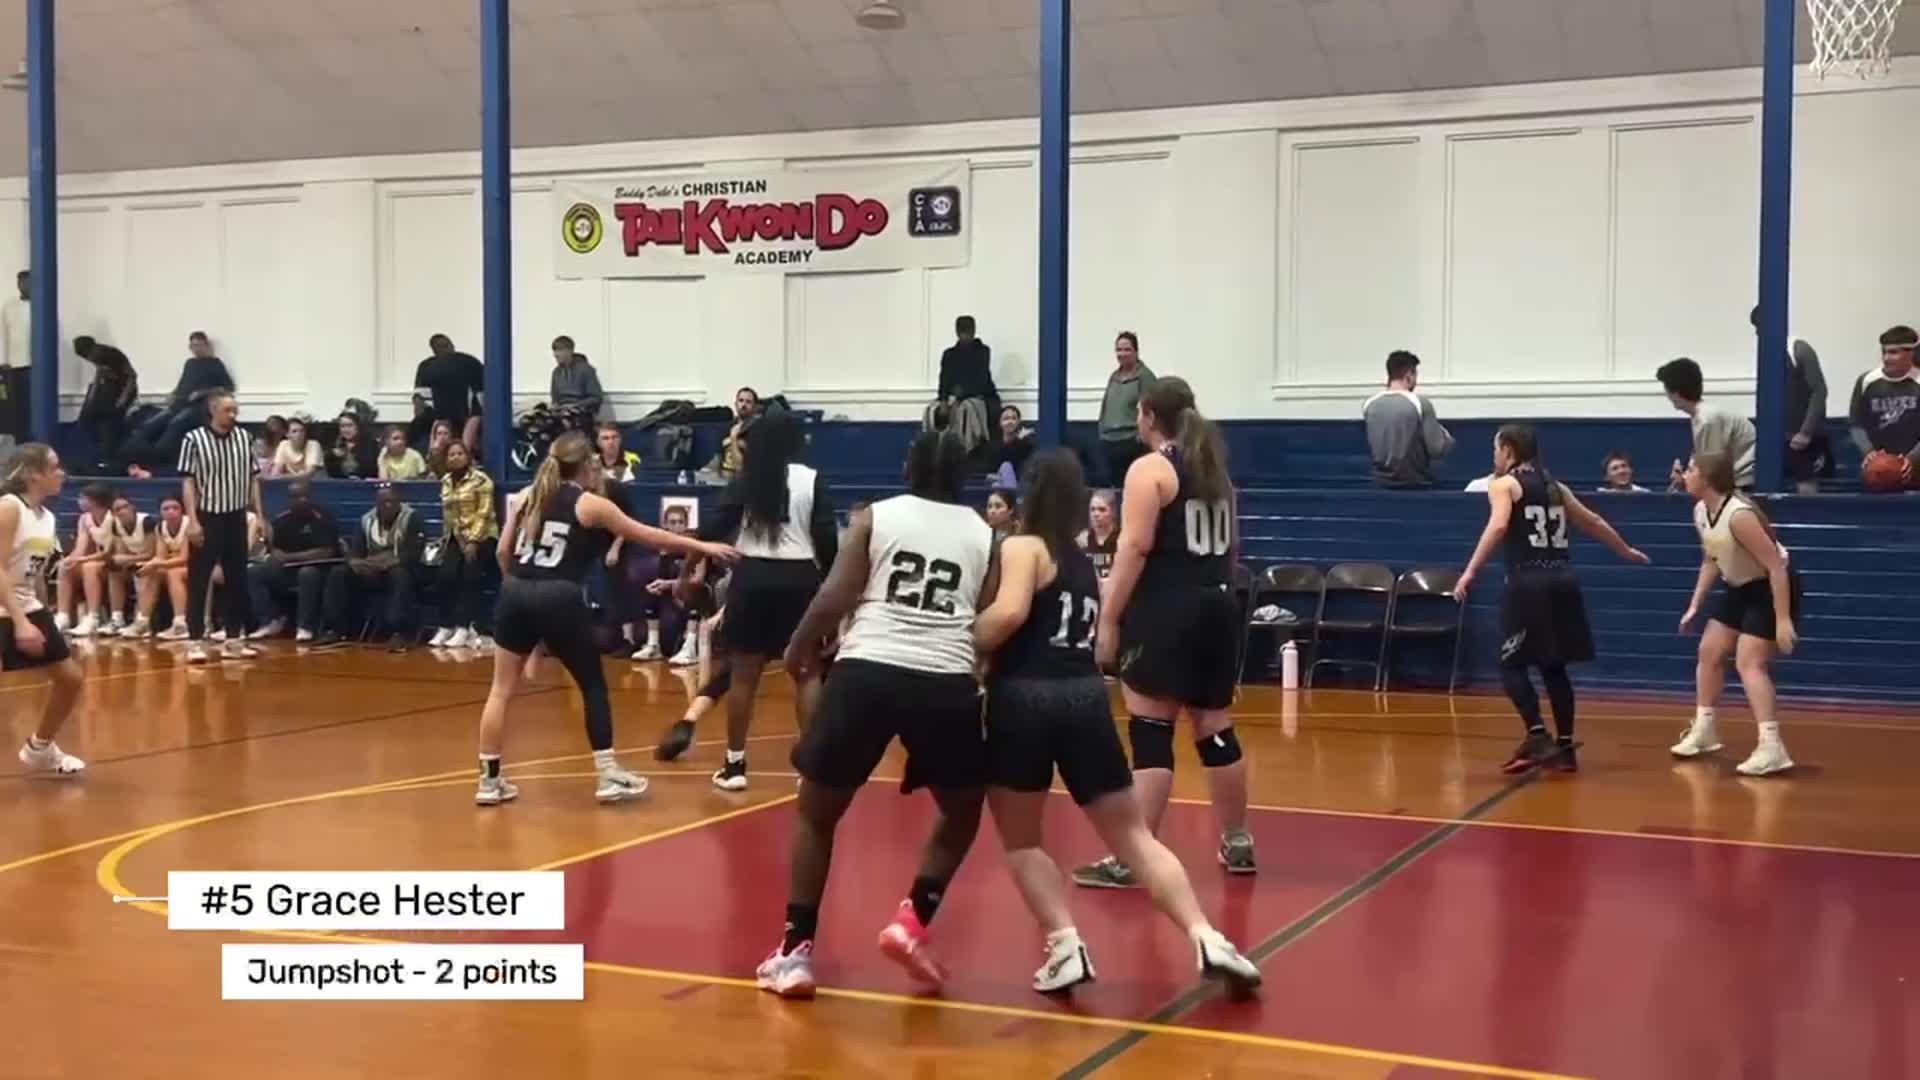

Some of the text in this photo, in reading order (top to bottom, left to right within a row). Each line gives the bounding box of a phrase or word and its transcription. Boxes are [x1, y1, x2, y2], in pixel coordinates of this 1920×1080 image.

[682, 180, 767, 196] CHRISTIAN
[734, 249, 813, 265] ACADEMY
[514, 520, 571, 567] 45
[1185, 498, 1230, 556] 00
[1524, 505, 1569, 548] 32
[885, 551, 963, 615] 22
